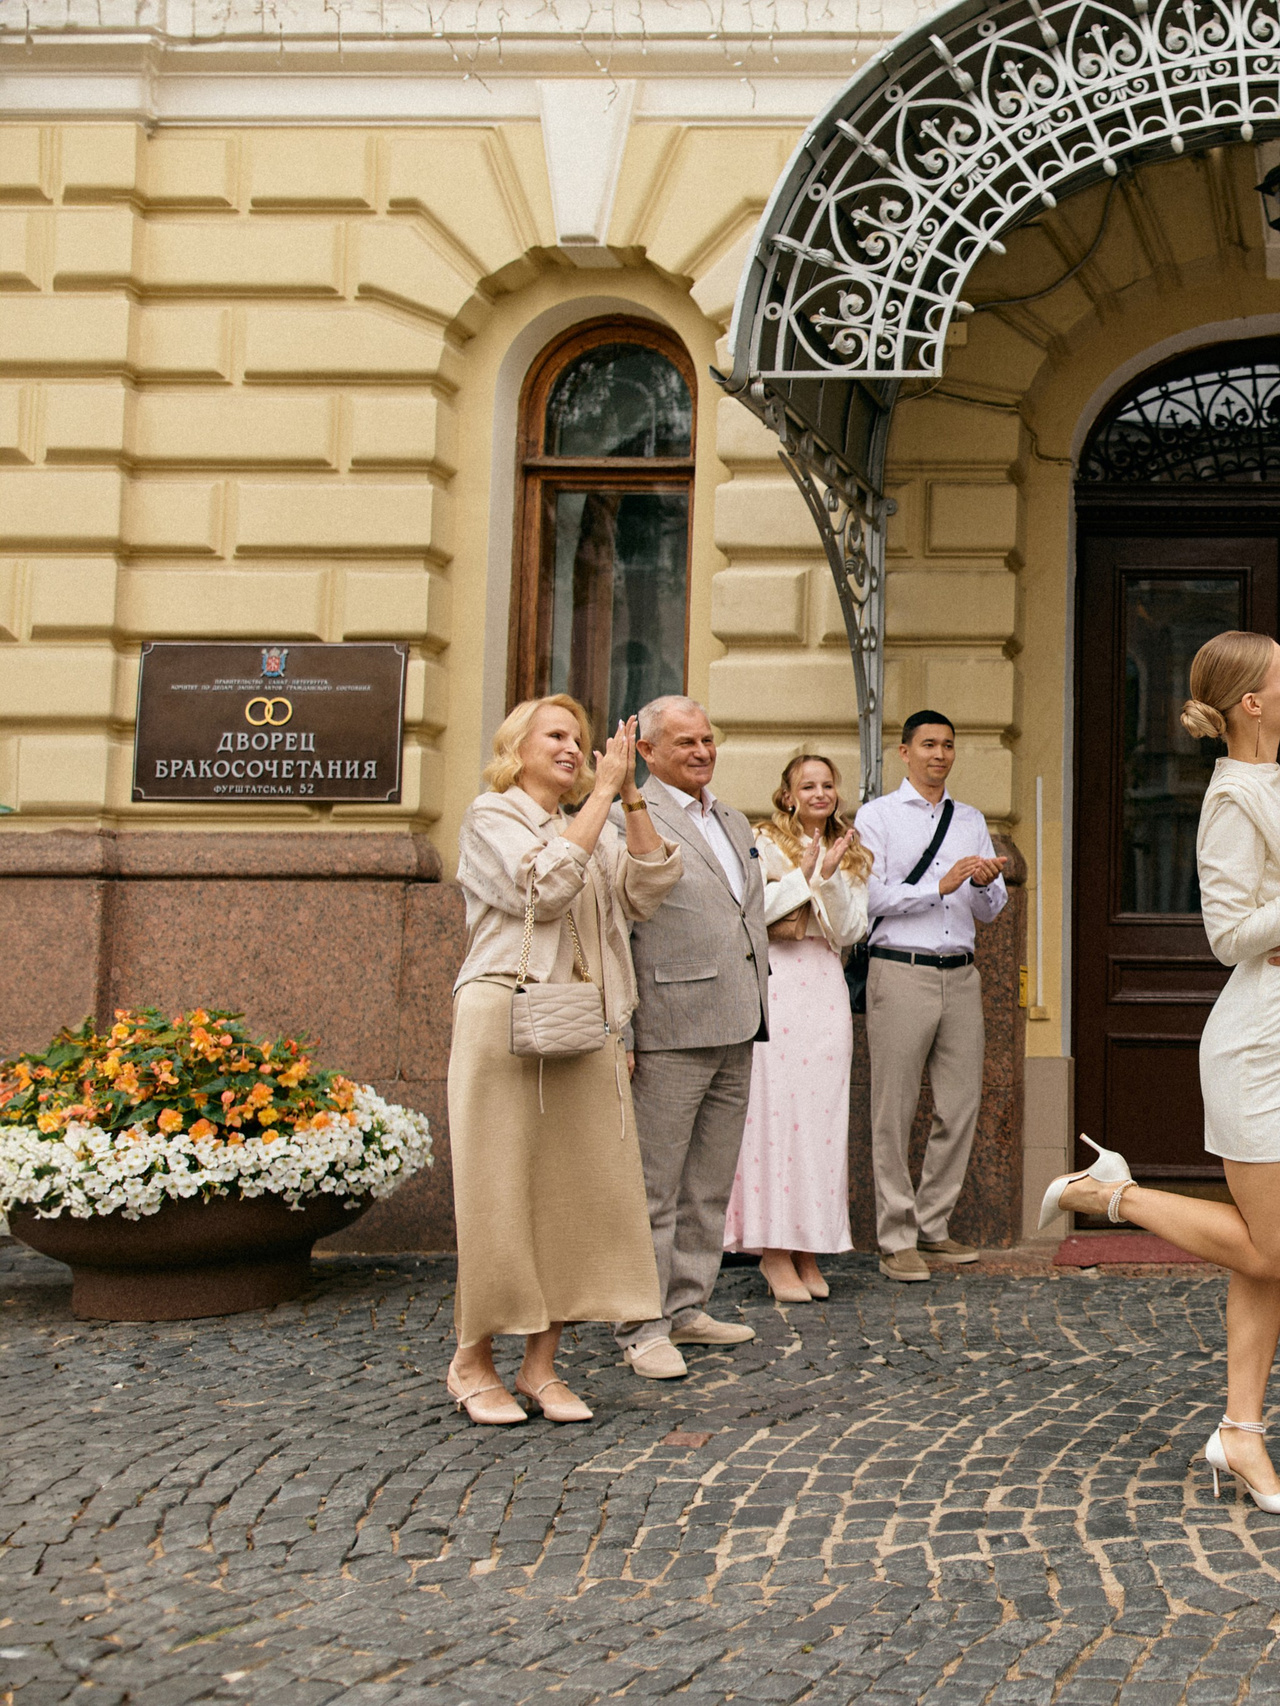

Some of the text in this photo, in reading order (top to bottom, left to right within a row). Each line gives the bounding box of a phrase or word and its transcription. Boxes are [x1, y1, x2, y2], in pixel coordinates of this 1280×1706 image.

[216, 732, 315, 753] ДВОРЕЦ
[155, 759, 378, 780] БРАКОСОЧЕТАНИЯ
[299, 783, 314, 794] 52
